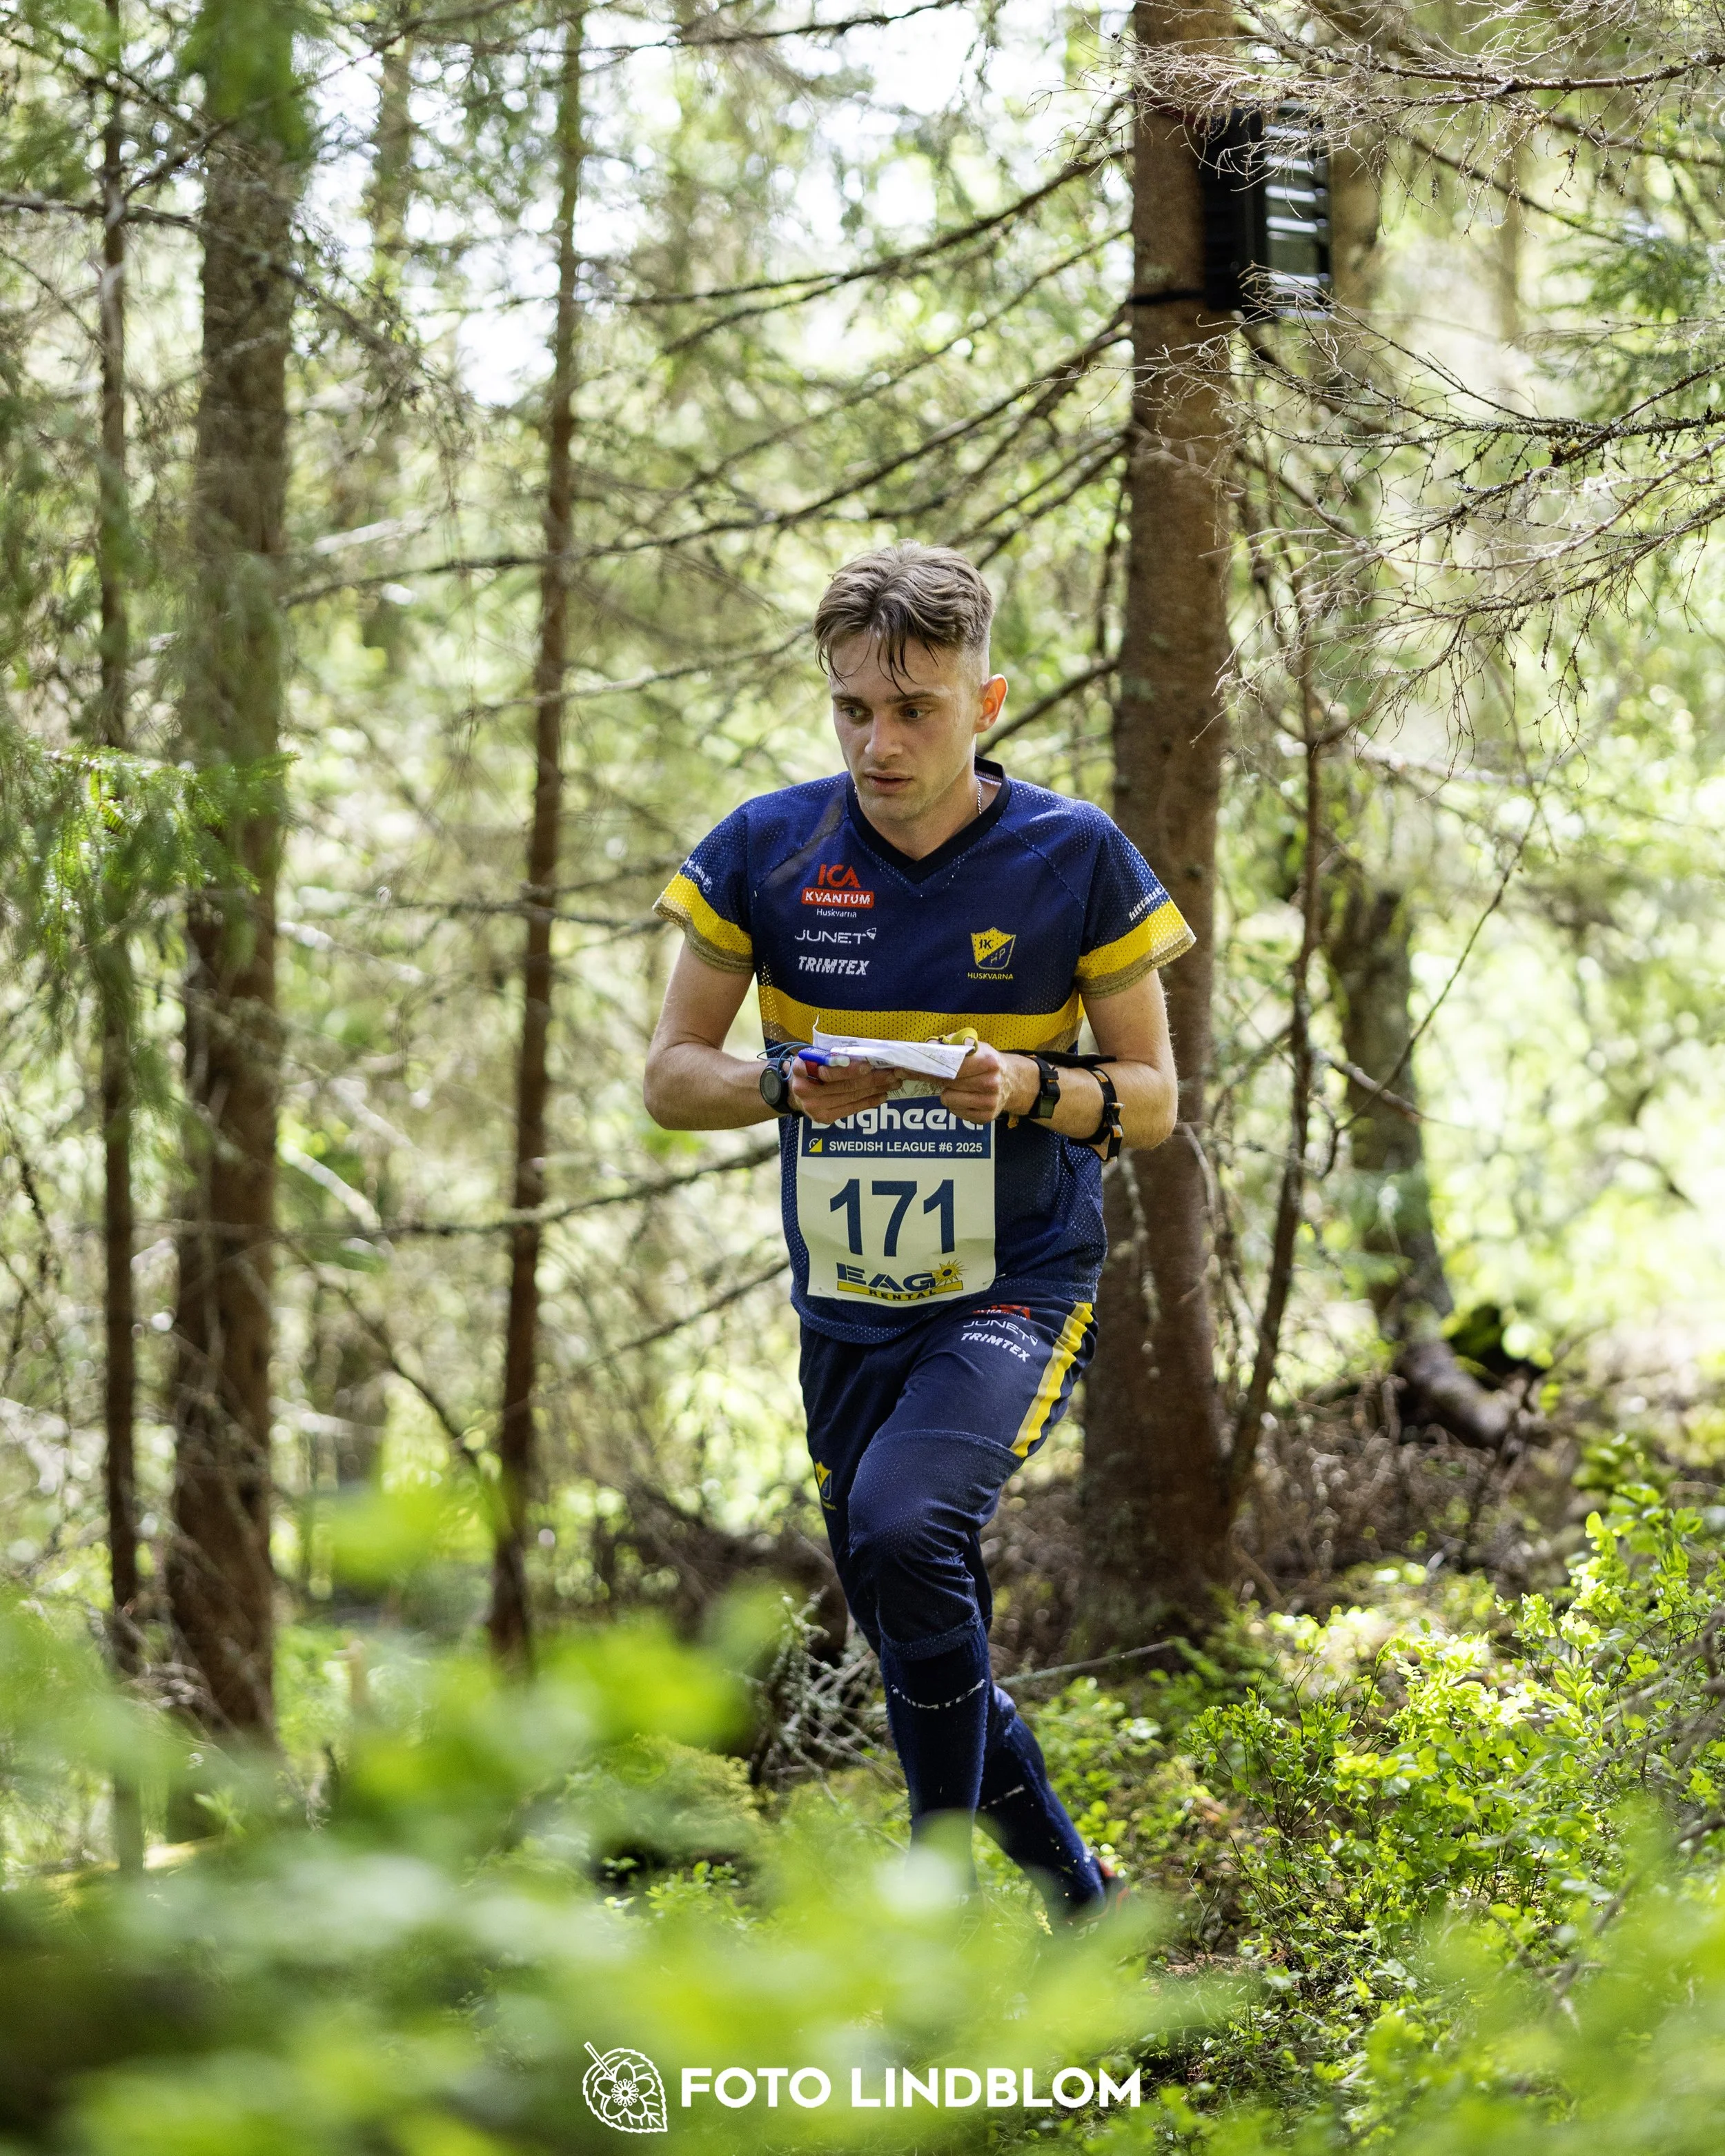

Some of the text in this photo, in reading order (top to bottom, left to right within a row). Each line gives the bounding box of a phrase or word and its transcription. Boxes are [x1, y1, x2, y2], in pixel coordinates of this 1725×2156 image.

[818, 863, 861, 889] ICA
[805, 891, 871, 904] KVANTUM
[816, 908, 857, 918] Huskvarna
[794, 929, 867, 945] JUNET
[979, 938, 992, 949] IK
[798, 956, 870, 976] TRIMTEX
[967, 971, 1014, 980] HUSKVARNA
[829, 1141, 983, 1153] SWEDISH LEAGUE #6 2025
[829, 1178, 955, 1257] 171
[869, 1288, 937, 1300] RENTAL
[963, 1320, 1030, 1341] JUNET
[961, 1332, 1031, 1363] TRIMTEX
